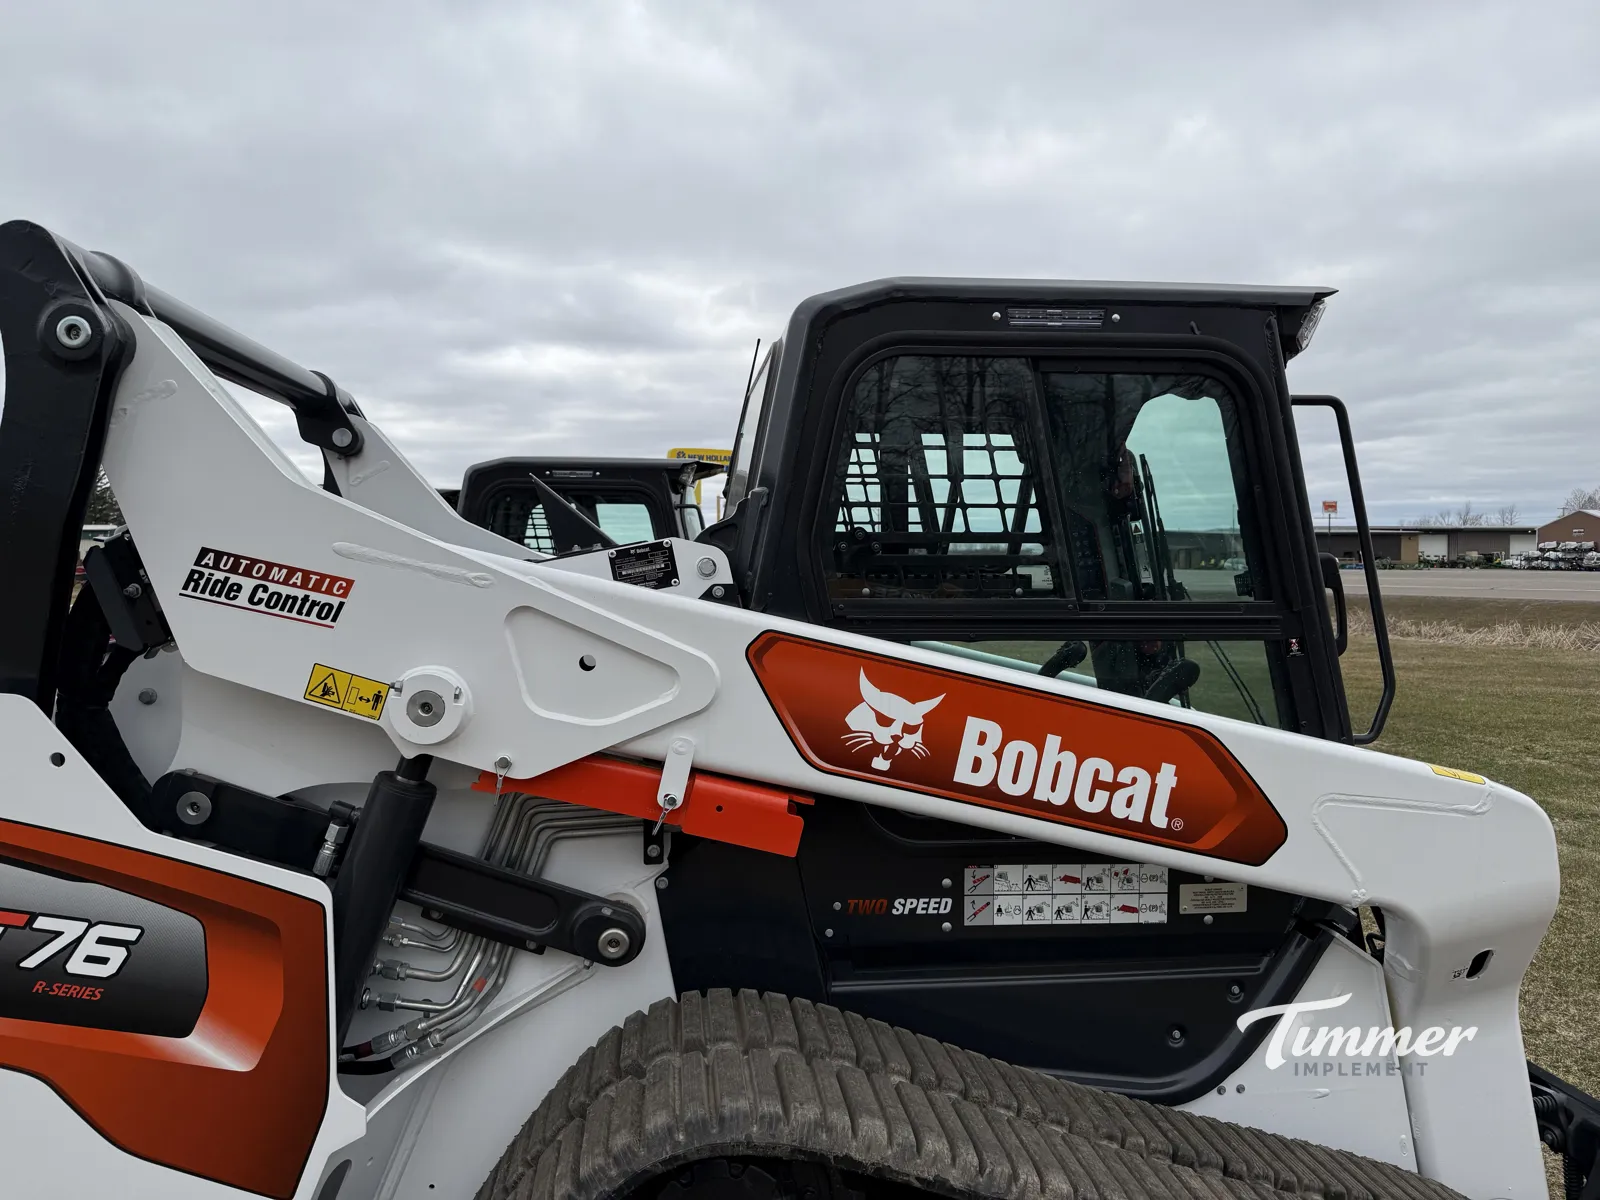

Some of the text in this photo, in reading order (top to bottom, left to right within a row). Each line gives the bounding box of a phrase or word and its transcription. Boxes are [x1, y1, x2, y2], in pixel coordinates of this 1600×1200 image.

[201, 552, 347, 595] AUTOMATIC
[181, 568, 346, 623] Ride Control
[953, 715, 1178, 829] Bobcat
[847, 898, 953, 915] TWO SPEED
[32, 980, 104, 1001] R-SERIES
